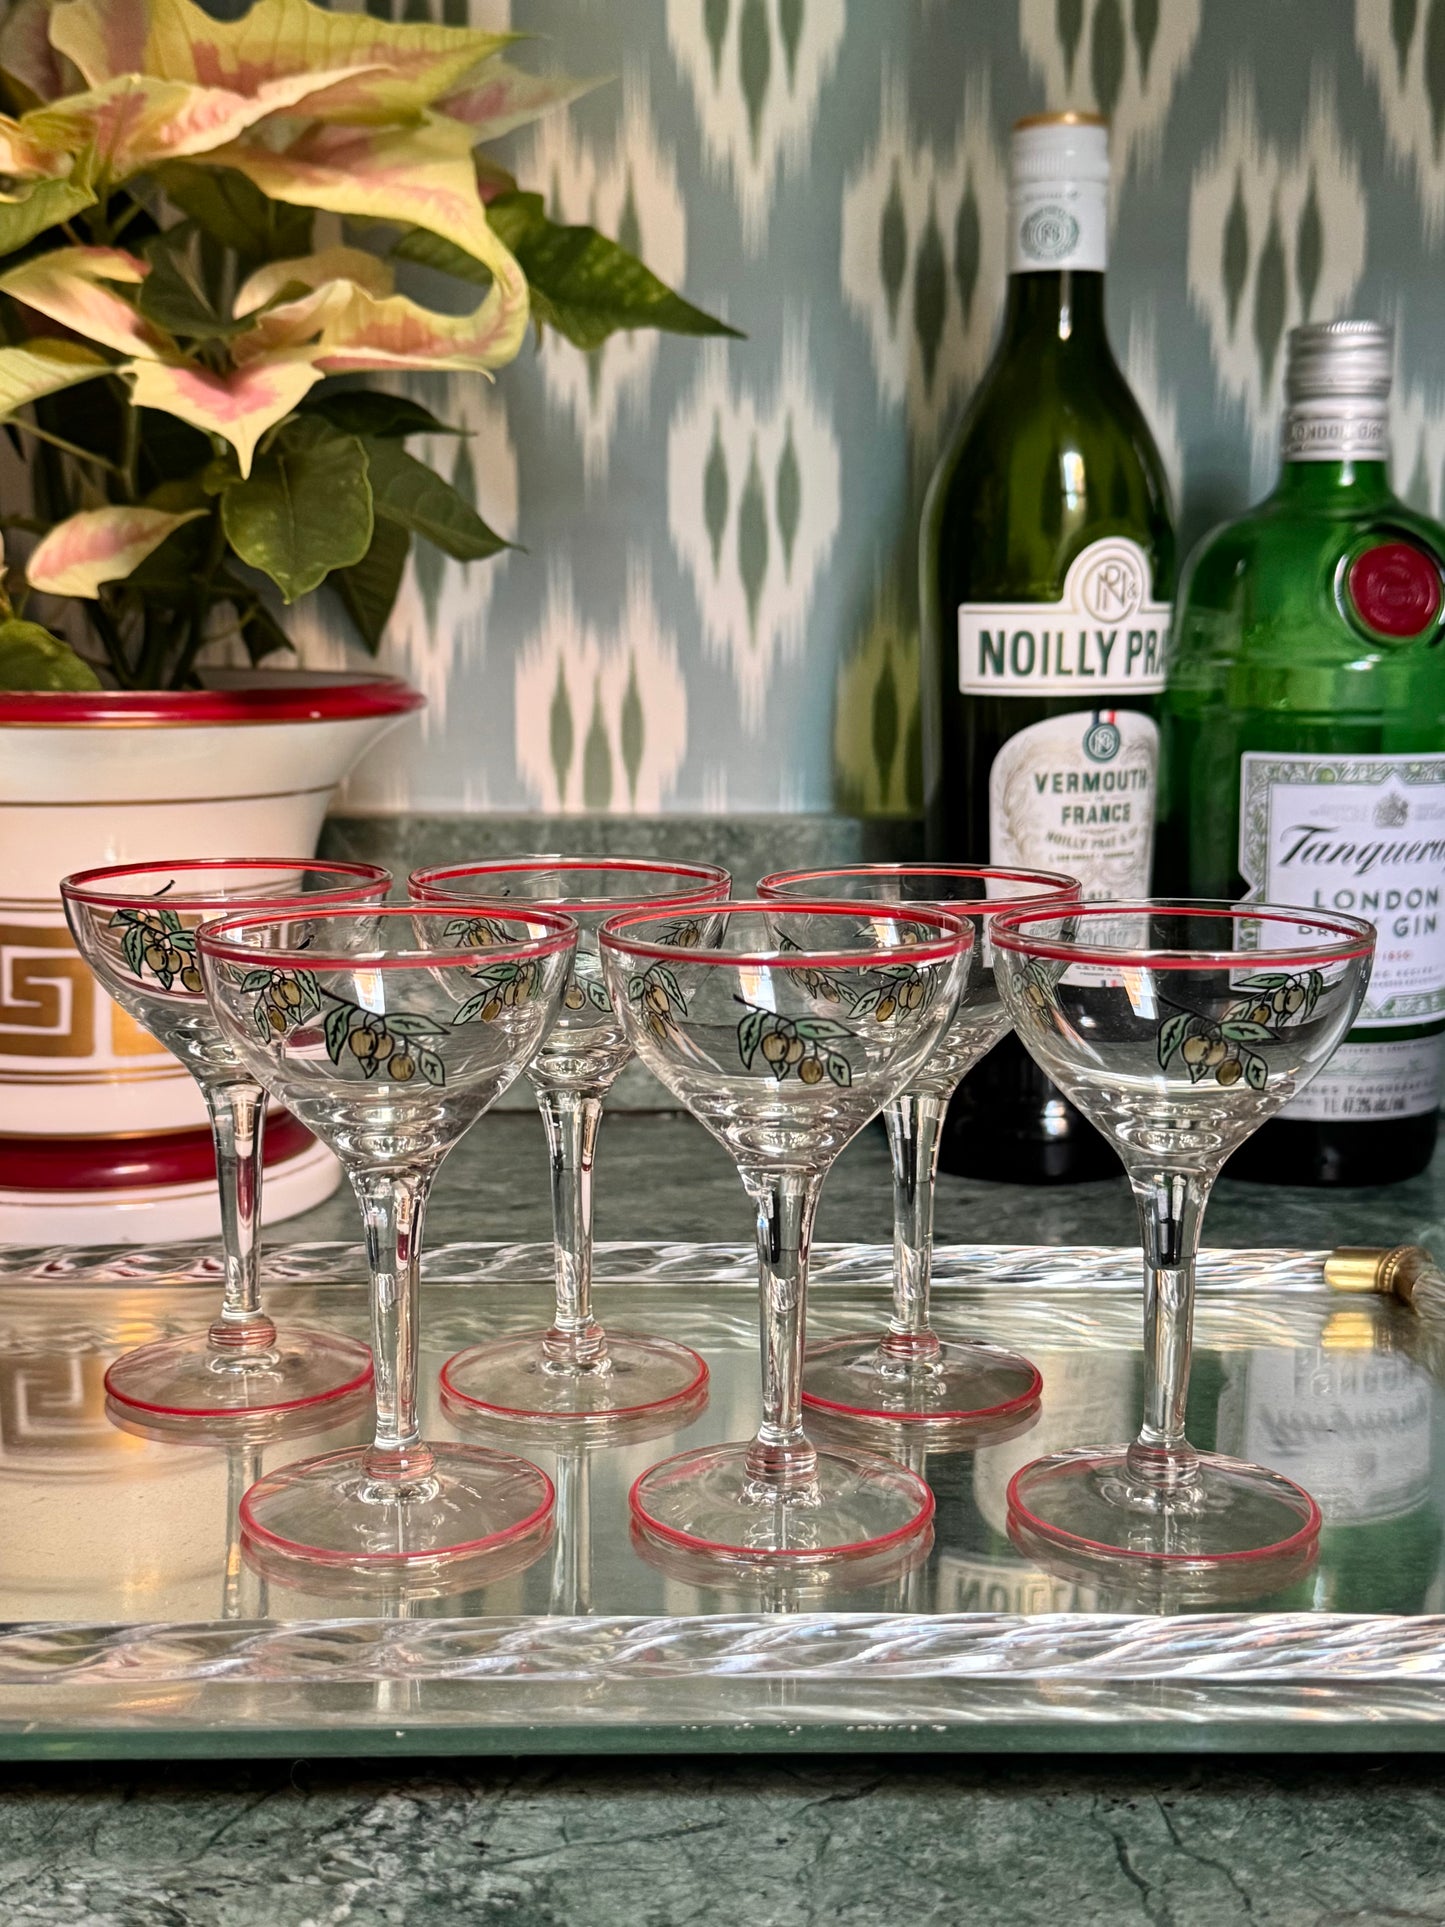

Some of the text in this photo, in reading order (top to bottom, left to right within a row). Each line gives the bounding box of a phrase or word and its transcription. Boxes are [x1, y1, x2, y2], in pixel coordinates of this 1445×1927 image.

[978, 629, 1118, 676] NOILLY
[1035, 769, 1148, 794] VERMOUTH
[1061, 803, 1131, 826] FRANCE
[1313, 886, 1440, 910] LONDON
[1393, 914, 1437, 938] GIN
